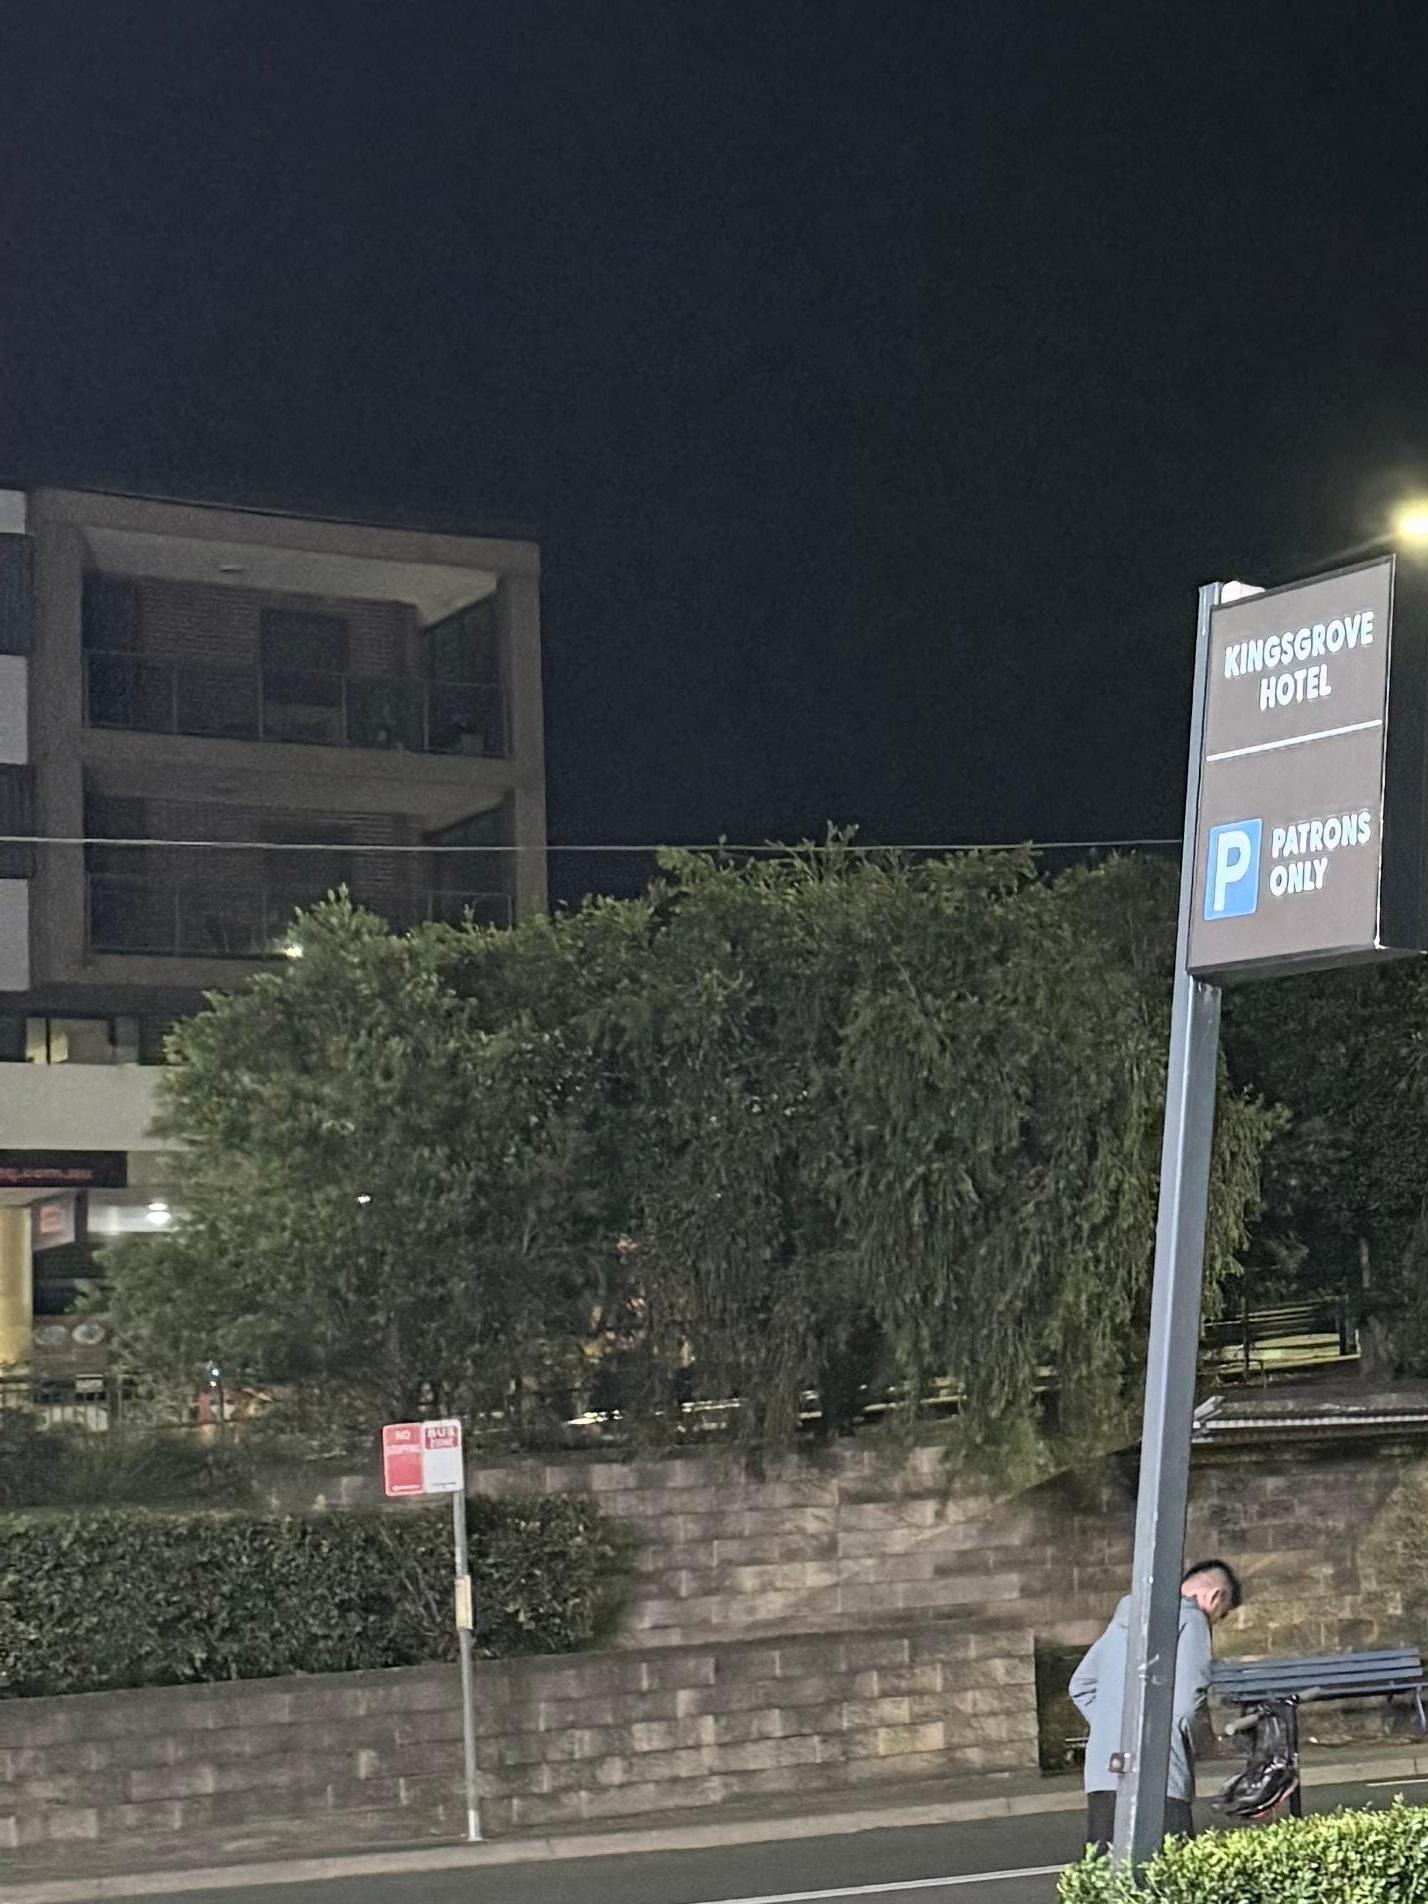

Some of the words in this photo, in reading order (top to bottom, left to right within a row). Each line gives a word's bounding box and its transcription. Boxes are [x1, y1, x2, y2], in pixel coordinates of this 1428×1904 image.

[1224, 611, 1374, 678] KINGSGROVE
[1259, 663, 1332, 711] HOTEL
[1271, 811, 1372, 858] PATRONS
[1213, 830, 1251, 912] P
[1269, 857, 1328, 896] ONLY
